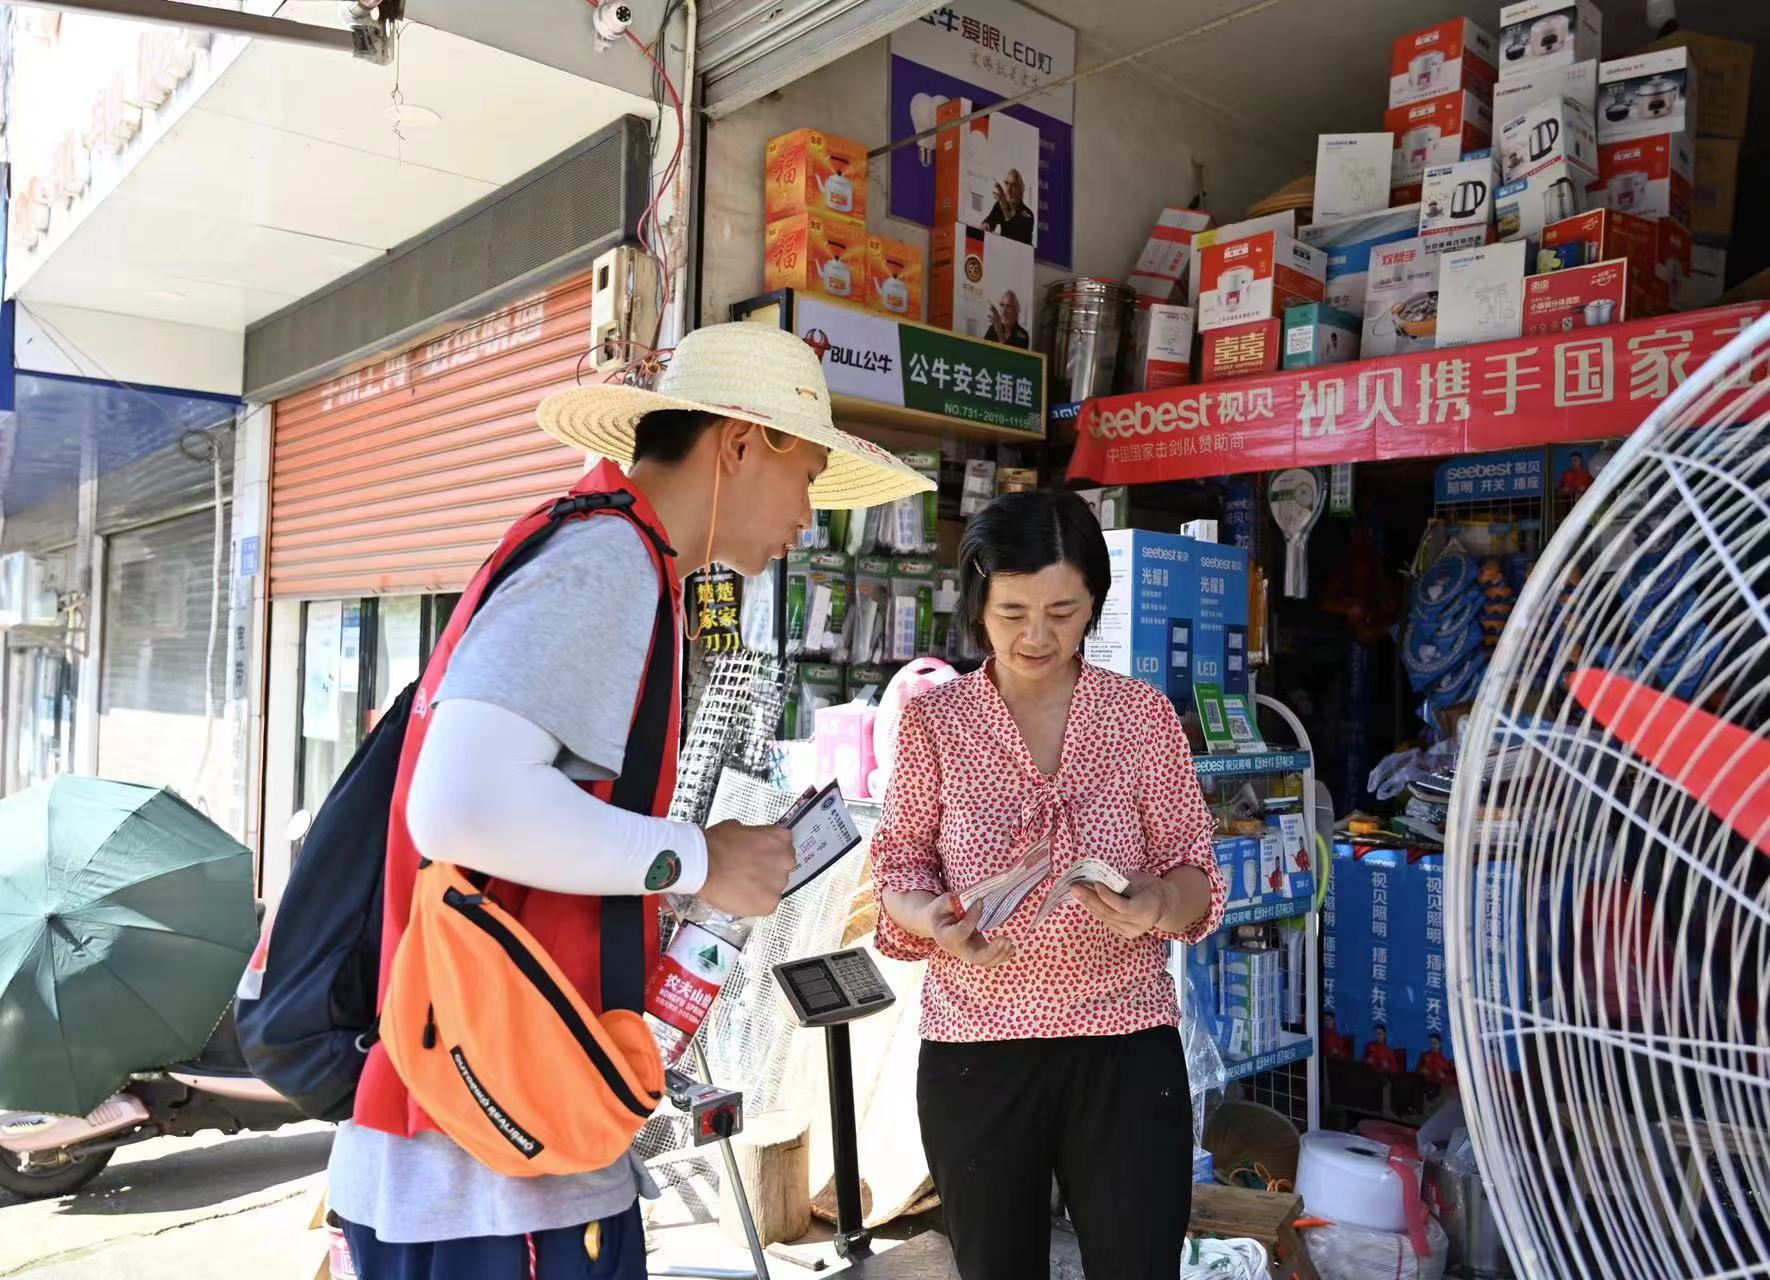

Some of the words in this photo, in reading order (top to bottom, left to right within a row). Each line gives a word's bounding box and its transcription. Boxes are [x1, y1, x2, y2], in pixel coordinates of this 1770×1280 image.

[774, 149, 797, 188] 福
[774, 232, 797, 272] 福
[908, 352, 1033, 408] 公牛安全插座
[1217, 387, 1275, 423] 视贝
[1106, 431, 1245, 463] 中国国家击剑队赞助商
[1447, 461, 1511, 479] seebest
[1515, 460, 1540, 474] 视贝
[1447, 481, 1473, 495] 照明
[1480, 479, 1505, 493] 开关
[1141, 546, 1176, 561] seebest
[1200, 556, 1232, 569] seebest
[1136, 657, 1159, 673] LED
[1198, 661, 1217, 677] LED
[1371, 871, 1387, 938] 视贝照明
[1426, 877, 1443, 945] 视贝照明
[1371, 947, 1387, 981] 插座
[1426, 953, 1443, 989] 插座
[1371, 986, 1387, 1023] 开关
[1426, 997, 1442, 1032] 开关
